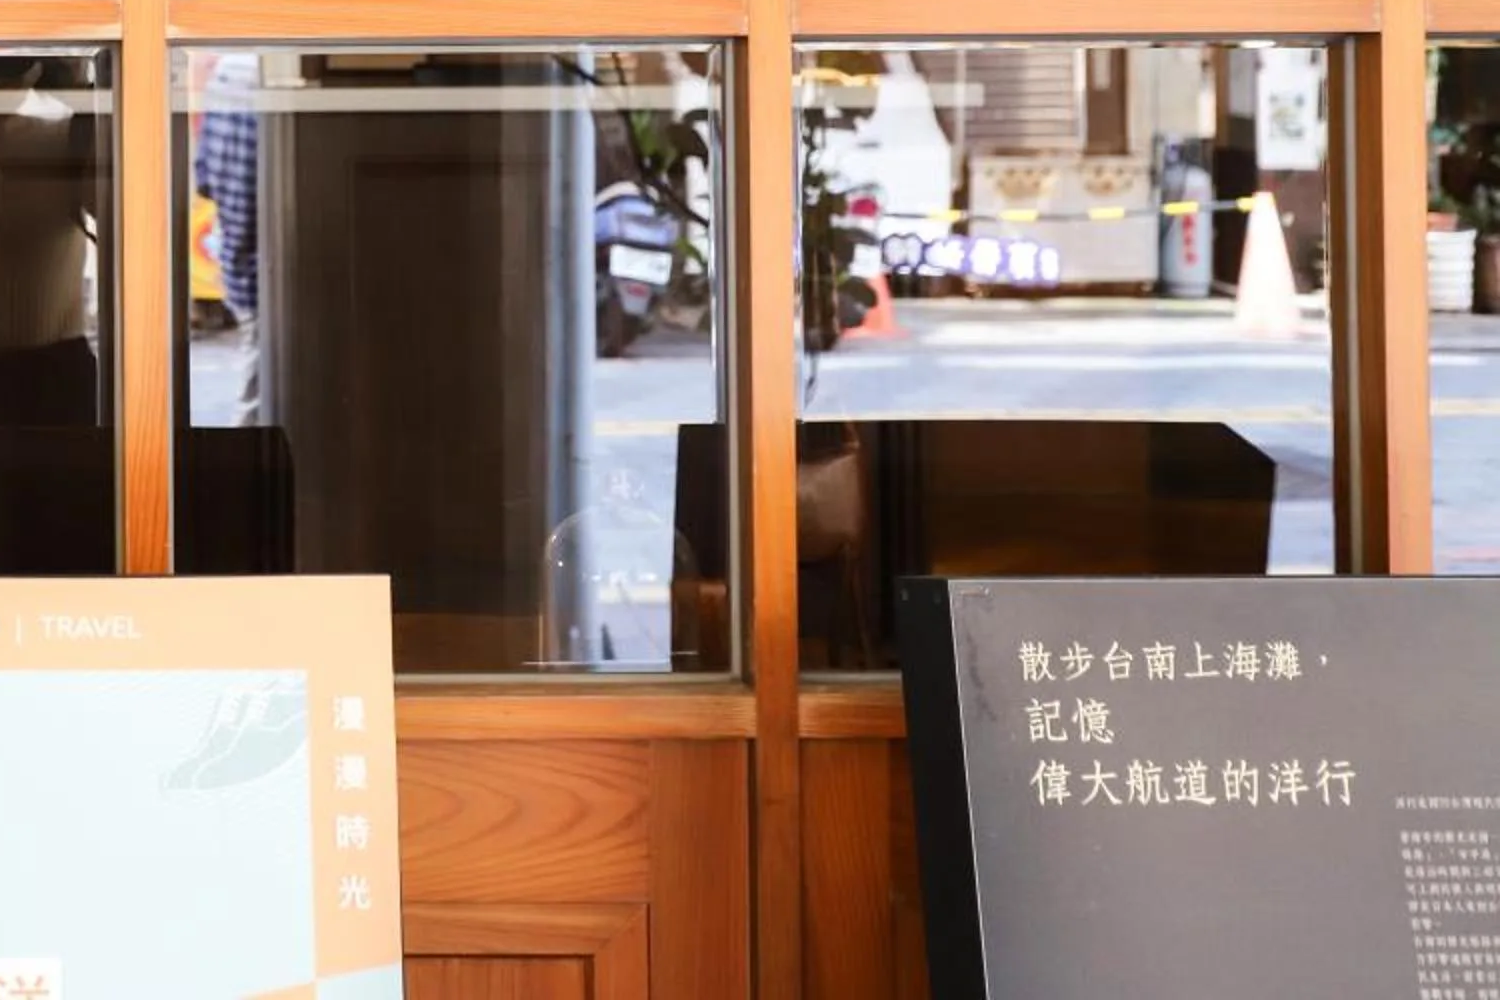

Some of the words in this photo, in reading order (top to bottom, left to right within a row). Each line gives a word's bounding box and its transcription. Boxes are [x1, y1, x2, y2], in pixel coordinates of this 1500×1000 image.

[40, 614, 143, 640] TRAVEL
[1024, 697, 1116, 744] 記憶
[1029, 759, 1357, 808] 偉大航道的洋行
